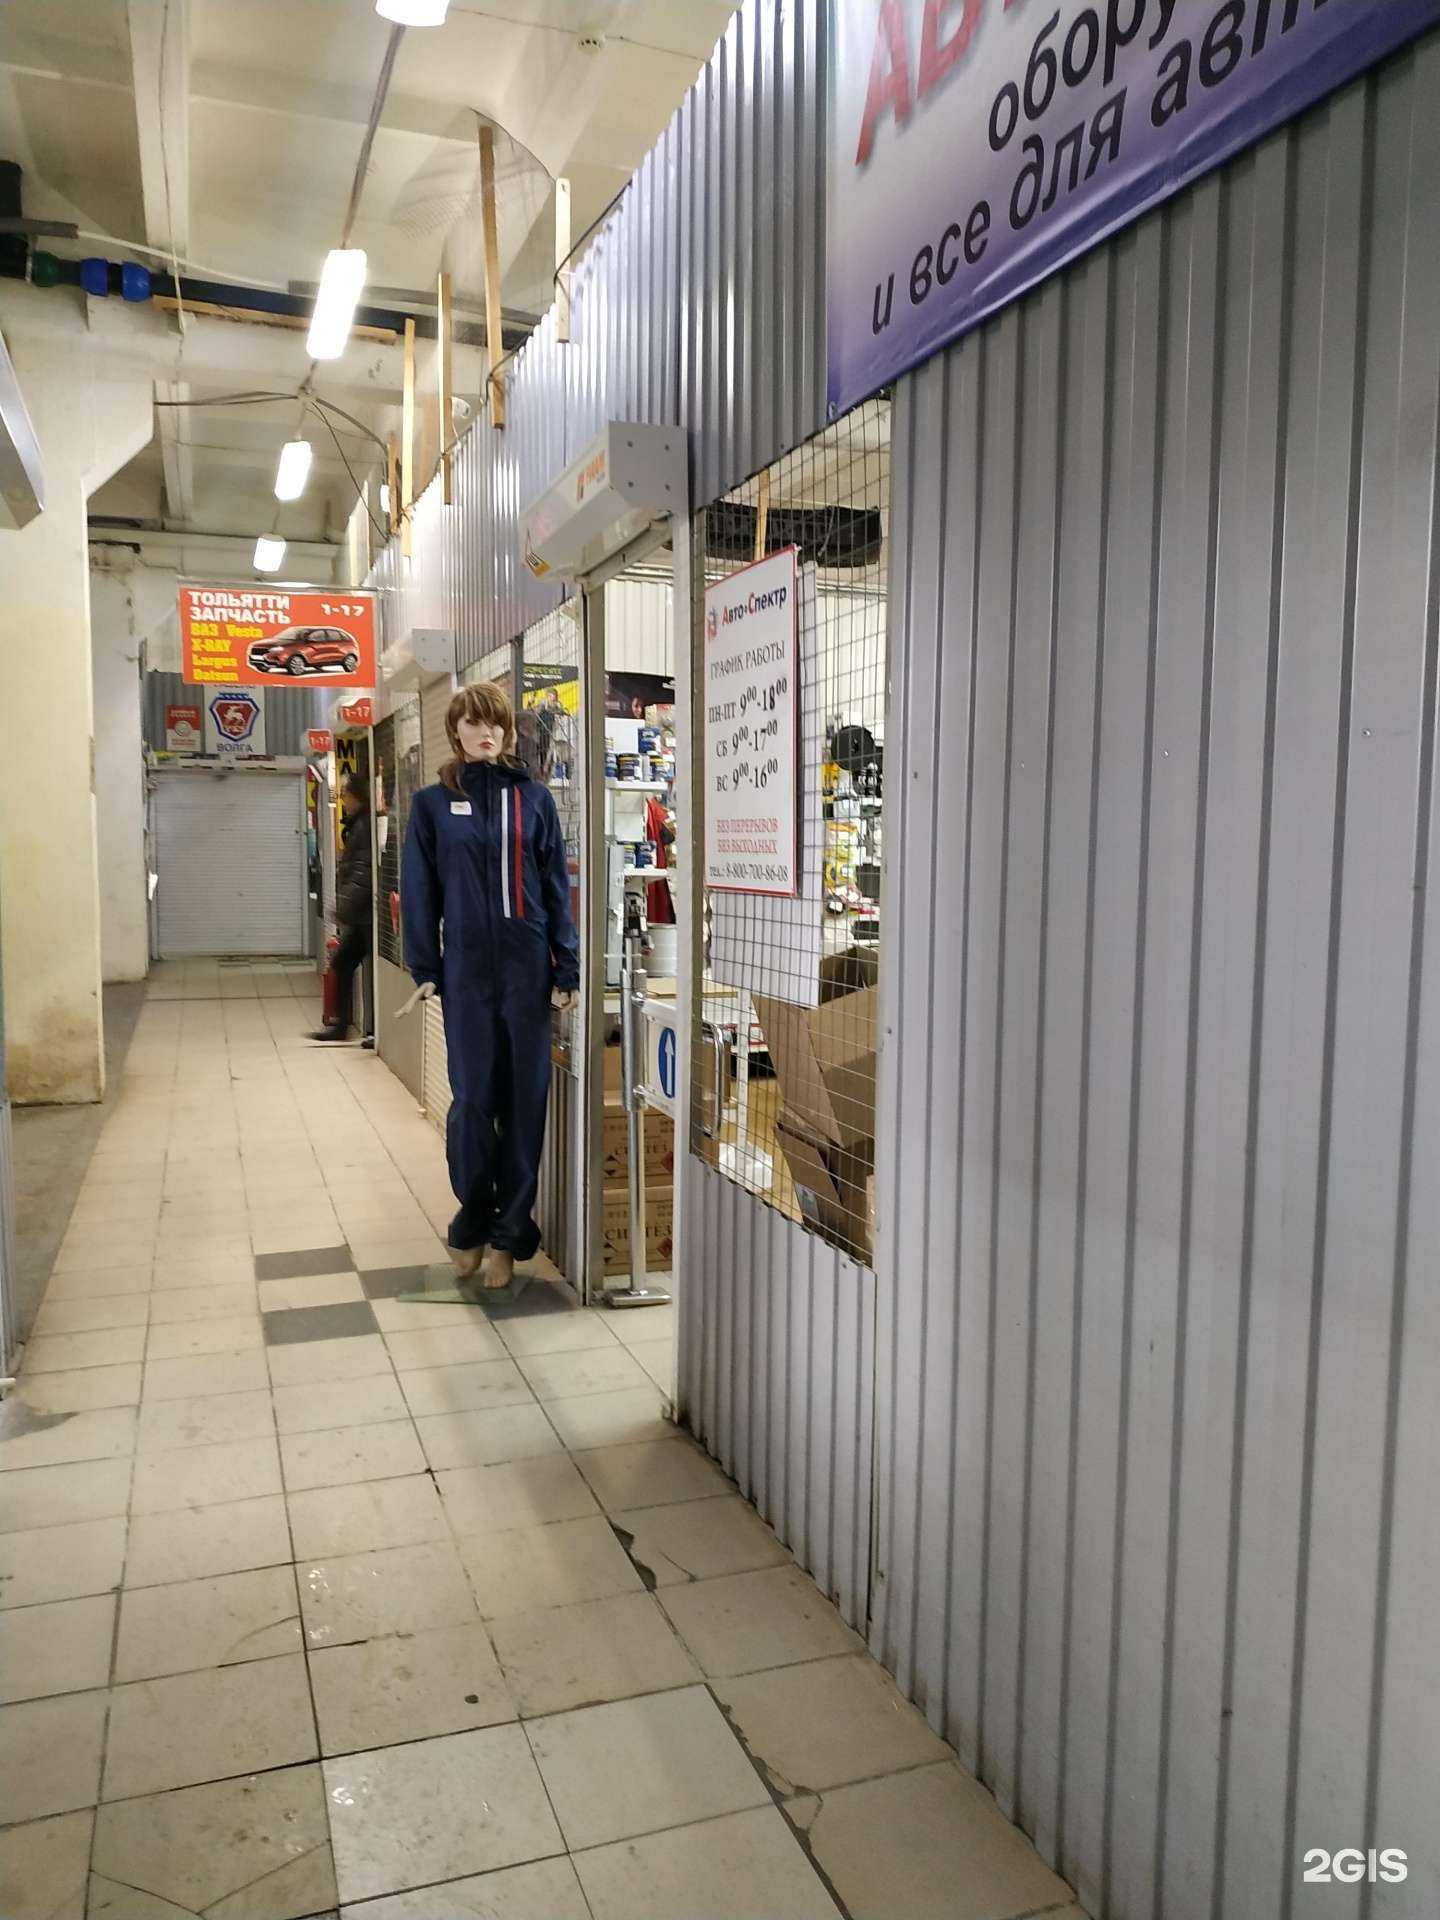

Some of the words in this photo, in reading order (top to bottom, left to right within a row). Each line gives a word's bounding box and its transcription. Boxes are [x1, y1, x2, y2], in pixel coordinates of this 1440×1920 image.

[872, 272, 896, 336] и
[909, 199, 992, 306] все
[1009, 87, 1129, 232] для
[188, 591, 290, 610] ТОЛЬЯТТИ
[321, 603, 365, 616] 1-17
[190, 607, 291, 625] ЗАПЧАСТЬ
[710, 653, 743, 680] ГРАФИК
[745, 640, 785, 668] РАБОТЫ
[708, 701, 736, 723] ПН-ПТ
[216, 743, 253, 753] ВОЛГА
[716, 740, 728, 757] СБ
[716, 775, 728, 792] ВС
